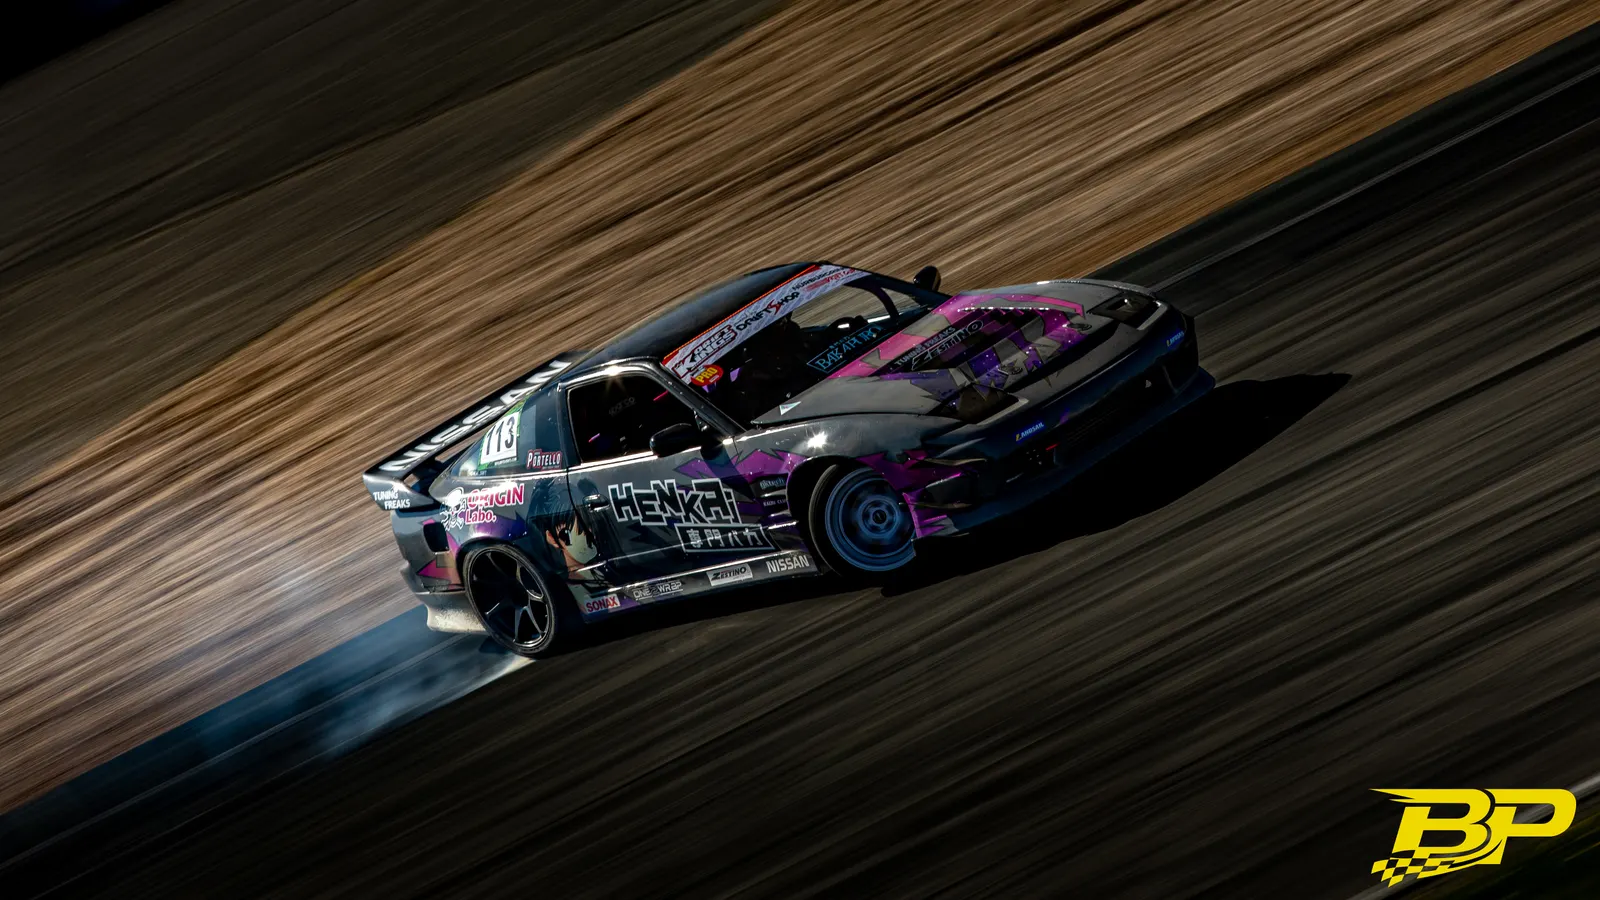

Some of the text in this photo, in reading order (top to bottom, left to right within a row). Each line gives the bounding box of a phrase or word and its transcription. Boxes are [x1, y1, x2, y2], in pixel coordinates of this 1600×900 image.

[693, 324, 731, 356] DRIFT
[893, 325, 956, 366] TUNING FREAKS
[675, 329, 736, 378] KINGS
[695, 366, 719, 384] PRO
[379, 360, 572, 472] NISSAN
[485, 415, 517, 457] 113
[527, 451, 561, 468] PORTELLO
[373, 489, 399, 501] TUNING
[384, 498, 411, 509] FREAKS
[467, 482, 525, 509] ORIGIN
[464, 509, 497, 525] Labo.
[766, 555, 810, 574] NISSAN
[711, 566, 747, 582] ZESTINO
[586, 596, 618, 613] SONAX
